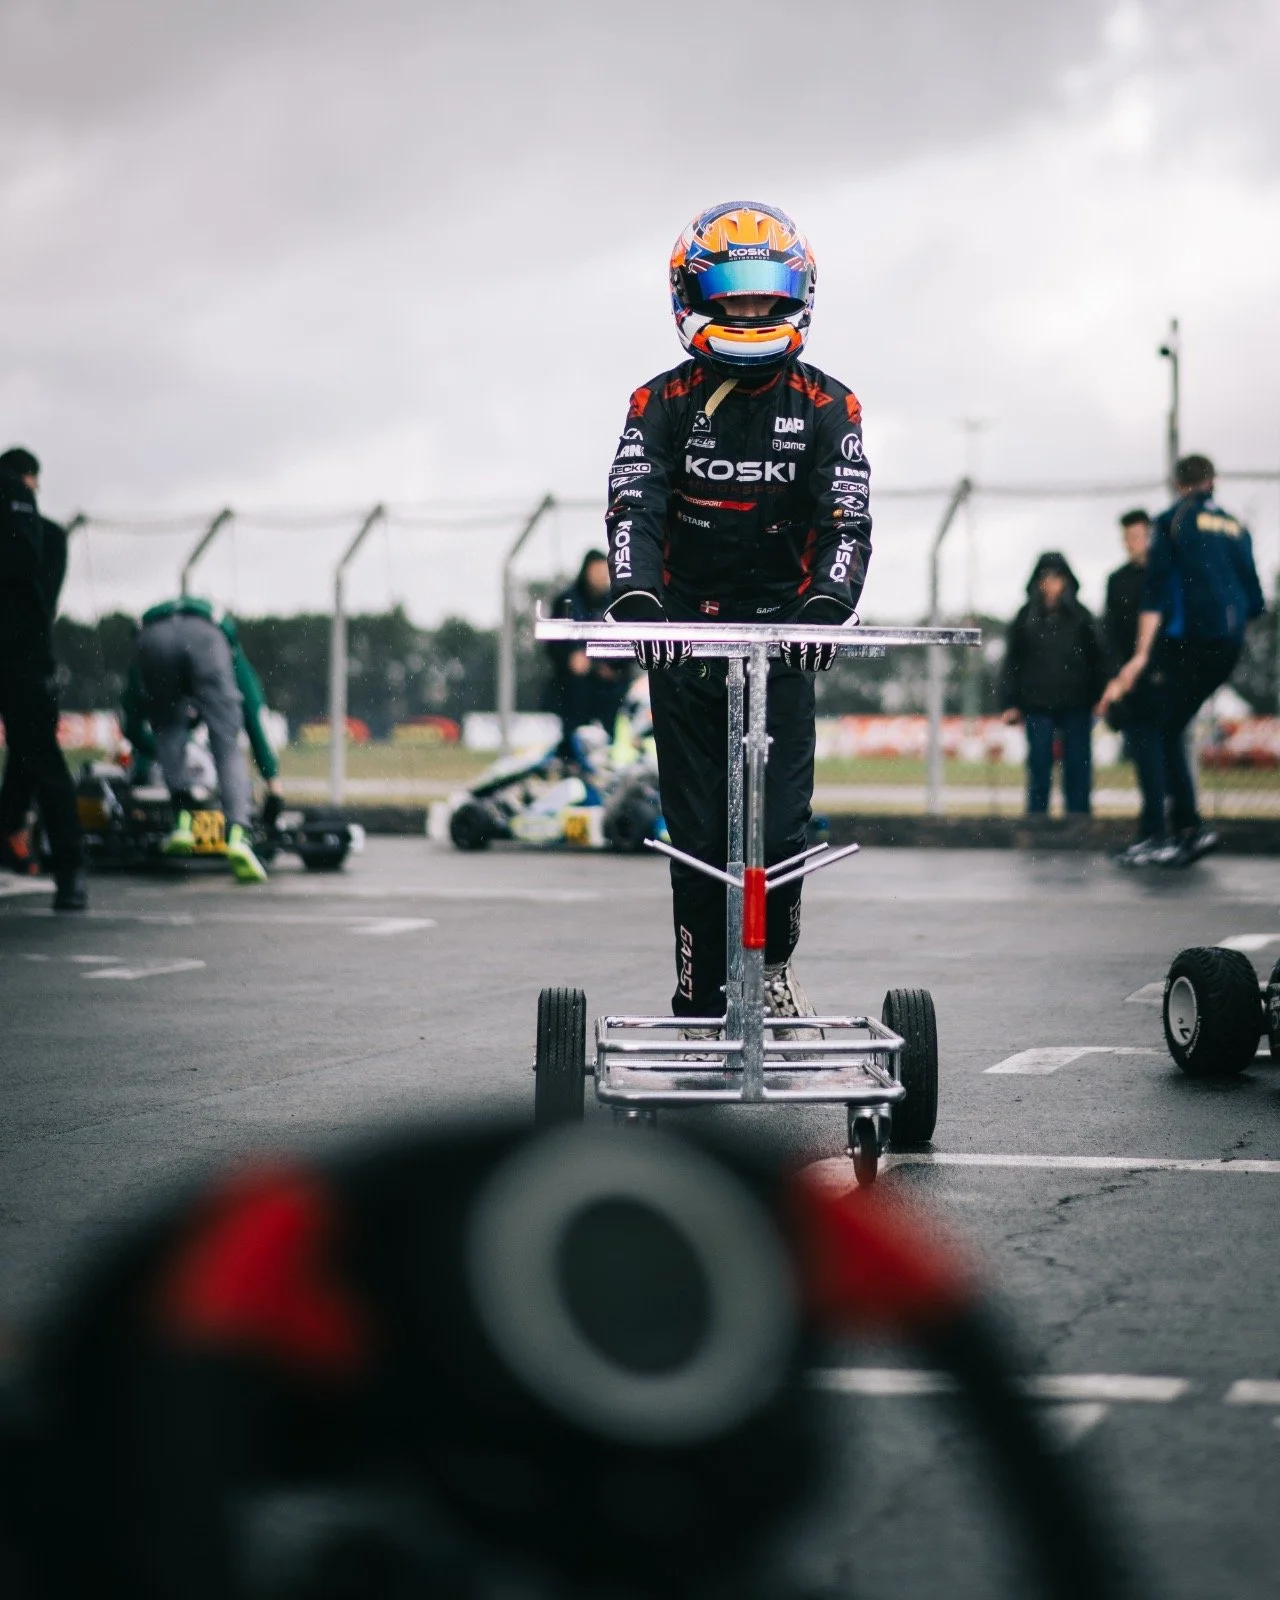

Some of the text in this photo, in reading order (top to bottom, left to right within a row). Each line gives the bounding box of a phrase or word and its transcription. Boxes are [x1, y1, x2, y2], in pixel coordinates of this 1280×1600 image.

[728, 248, 770, 257] KOSKI
[774, 416, 805, 433] DAP
[609, 464, 650, 475] JECKO
[685, 454, 796, 483] KOSKI
[618, 489, 643, 499] ARK
[843, 509, 869, 519] STA
[682, 514, 711, 529] STARK
[614, 520, 633, 579] KOSKI
